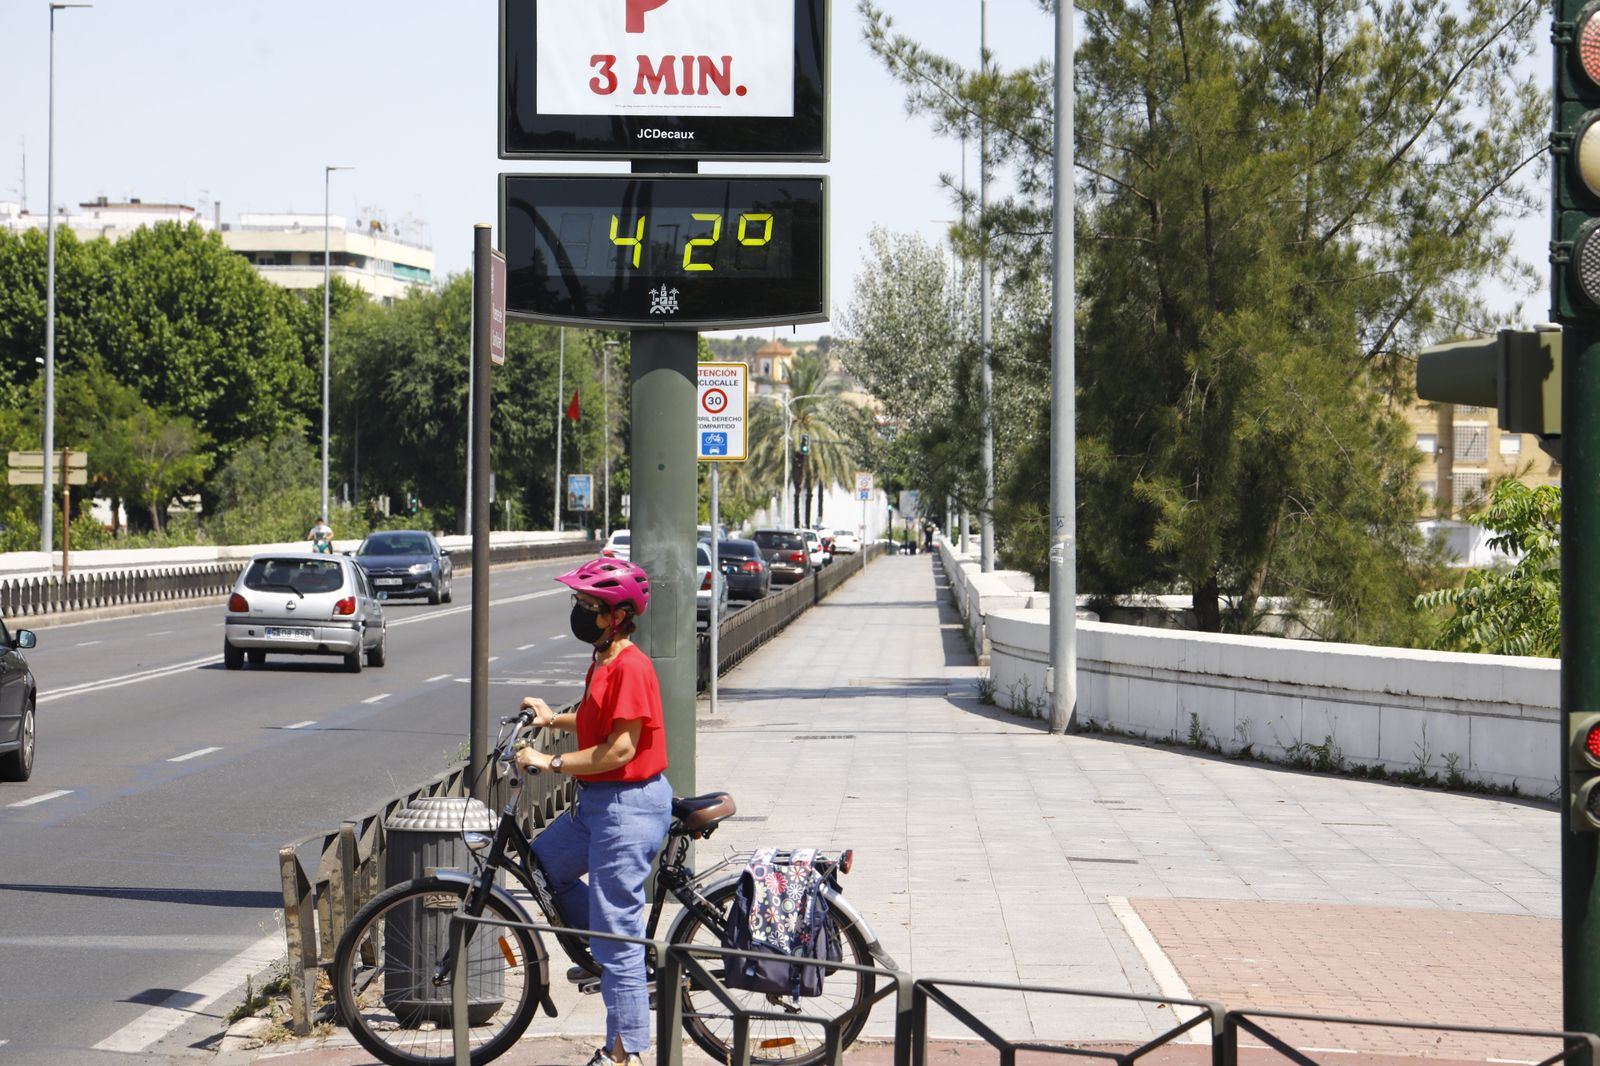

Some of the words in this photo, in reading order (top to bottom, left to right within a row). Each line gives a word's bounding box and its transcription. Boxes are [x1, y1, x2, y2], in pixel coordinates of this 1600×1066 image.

[589, 54, 618, 95] 3
[633, 55, 747, 96] MIN.
[637, 128, 695, 139] JCDecaux
[707, 396, 722, 405] 30
